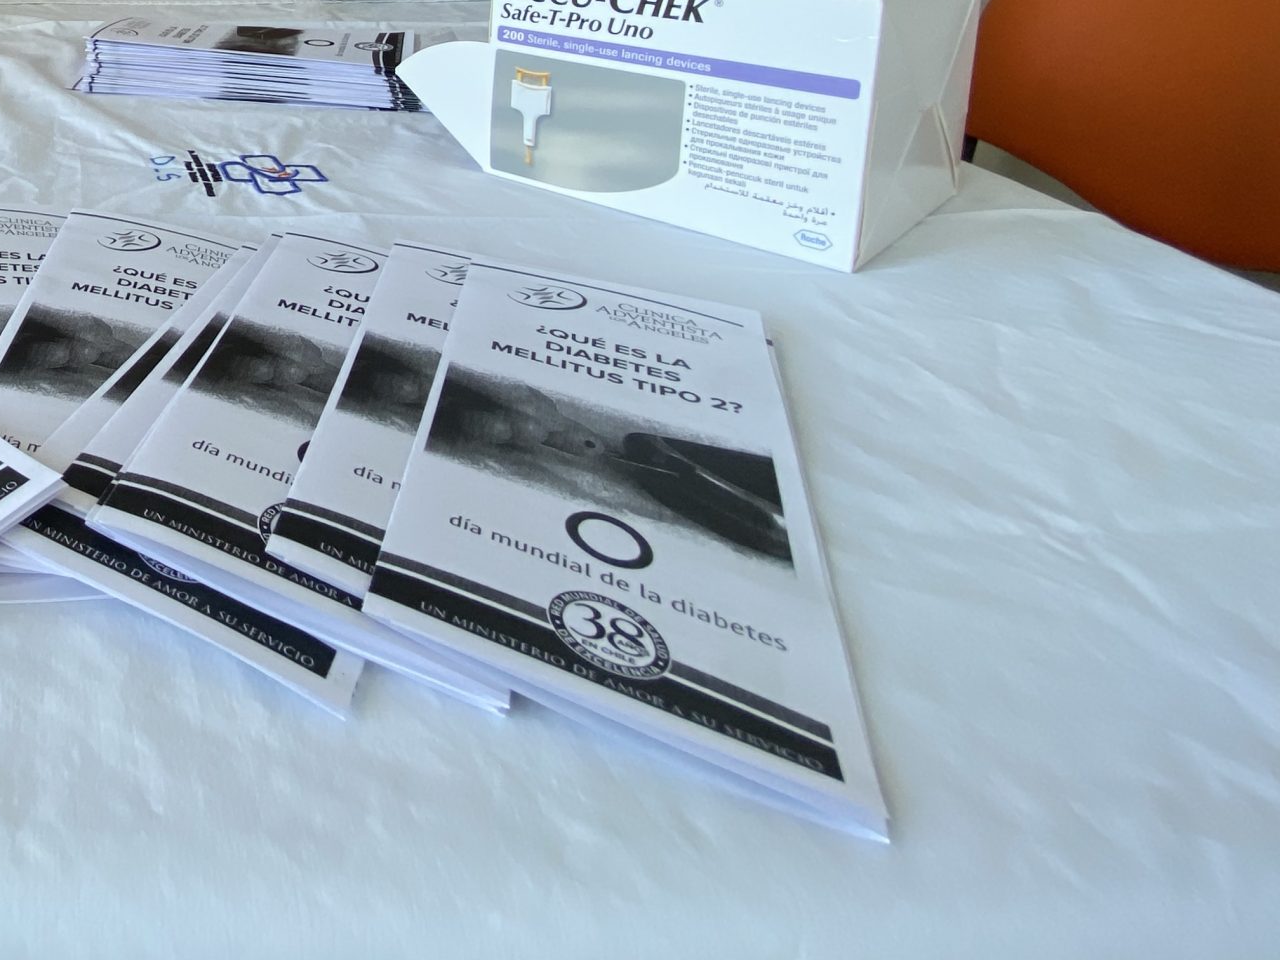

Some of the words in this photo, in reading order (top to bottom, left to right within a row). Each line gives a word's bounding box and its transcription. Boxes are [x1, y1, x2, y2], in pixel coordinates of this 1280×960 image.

[500, 3, 601, 32] Safe-T-Pro
[608, 18, 653, 40] Uno
[503, 30, 524, 41] 200
[527, 33, 560, 48] Sterile,
[563, 40, 618, 57] single-use
[622, 49, 662, 66] lancing
[666, 56, 711, 72] devices
[739, 110, 748, 118] de
[794, 100, 826, 113] devices
[113, 265, 167, 282] ¿QUÉ
[173, 277, 198, 289] ES
[117, 277, 194, 300] DIABET
[72, 282, 173, 310] MELLITUS
[278, 299, 360, 326] MELLIT
[595, 305, 724, 340] ADVENTISTA
[618, 303, 697, 326] CLINICA
[536, 325, 606, 349] ¿QUÉ
[615, 345, 647, 359] ES
[656, 354, 692, 370] LA
[627, 320, 710, 344] ANGELES
[545, 341, 681, 382] DIABETES
[491, 341, 624, 384] MELLITUS
[632, 378, 701, 403] TIPO
[711, 397, 743, 414] 2?
[192, 439, 220, 456] día
[226, 454, 293, 486] mundi
[354, 465, 383, 484] día
[143, 509, 166, 522] UN
[169, 519, 260, 564] MINISTERIO
[265, 561, 286, 575] DE
[288, 571, 338, 599] AMOR
[340, 596, 352, 606] A
[320, 542, 343, 558] UN
[450, 514, 482, 535] día
[491, 531, 592, 577] mundial
[601, 572, 630, 591] de
[640, 584, 662, 604] la
[671, 597, 788, 652] diabetes
[420, 601, 446, 618] UN
[452, 616, 565, 666] MINISTERIO
[572, 664, 597, 679] DE
[605, 677, 666, 708] AMOR
[672, 705, 684, 715] A
[692, 712, 716, 728] SU
[724, 724, 823, 770] SERVICIO
